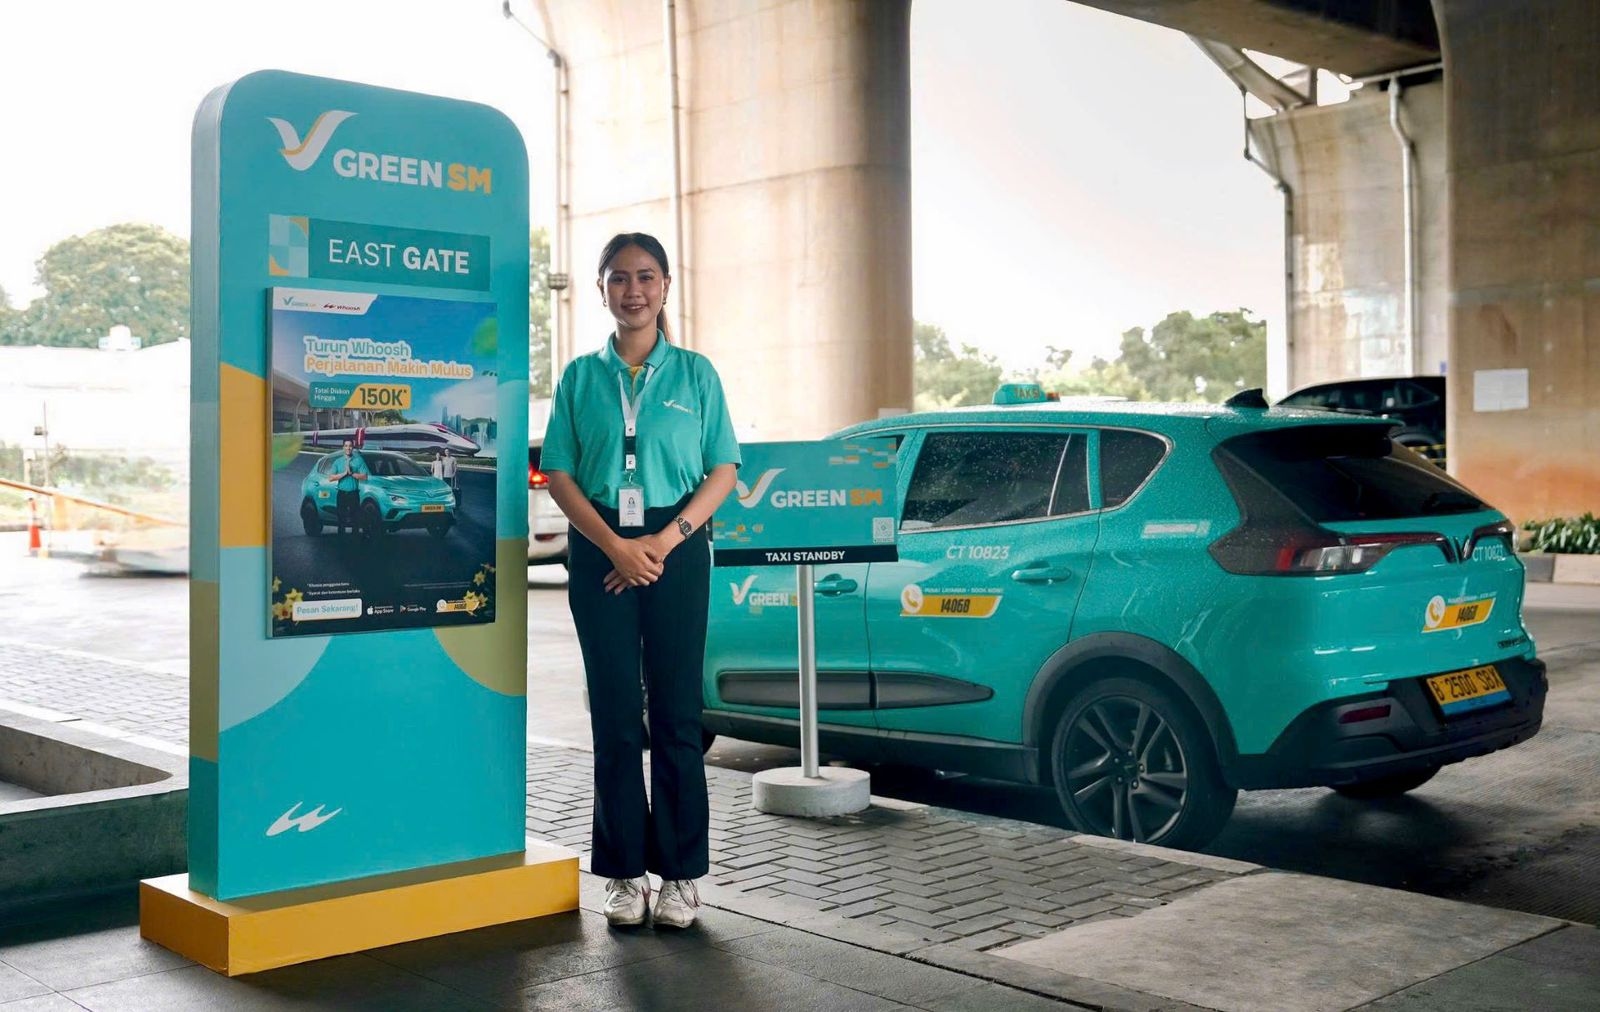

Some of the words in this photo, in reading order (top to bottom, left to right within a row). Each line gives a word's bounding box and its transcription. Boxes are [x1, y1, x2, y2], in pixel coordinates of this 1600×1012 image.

[333, 148, 442, 188] GREEN
[447, 163, 492, 194] SM
[329, 239, 396, 267] EAST
[402, 246, 470, 274] GATE
[306, 338, 348, 354] Turun
[351, 340, 410, 356] Whoosh
[306, 357, 385, 374] Perjalanan
[387, 360, 428, 375] Makin
[431, 362, 472, 377] Mulus
[770, 489, 846, 508] GREEN
[850, 489, 882, 506] SM
[765, 552, 791, 562] TAXI
[793, 550, 846, 561] STANDBY
[946, 545, 966, 559] CT
[968, 545, 1010, 560] 10823
[749, 592, 789, 606] GREEN
[940, 598, 971, 613] 14068
[1431, 680, 1445, 701] B
